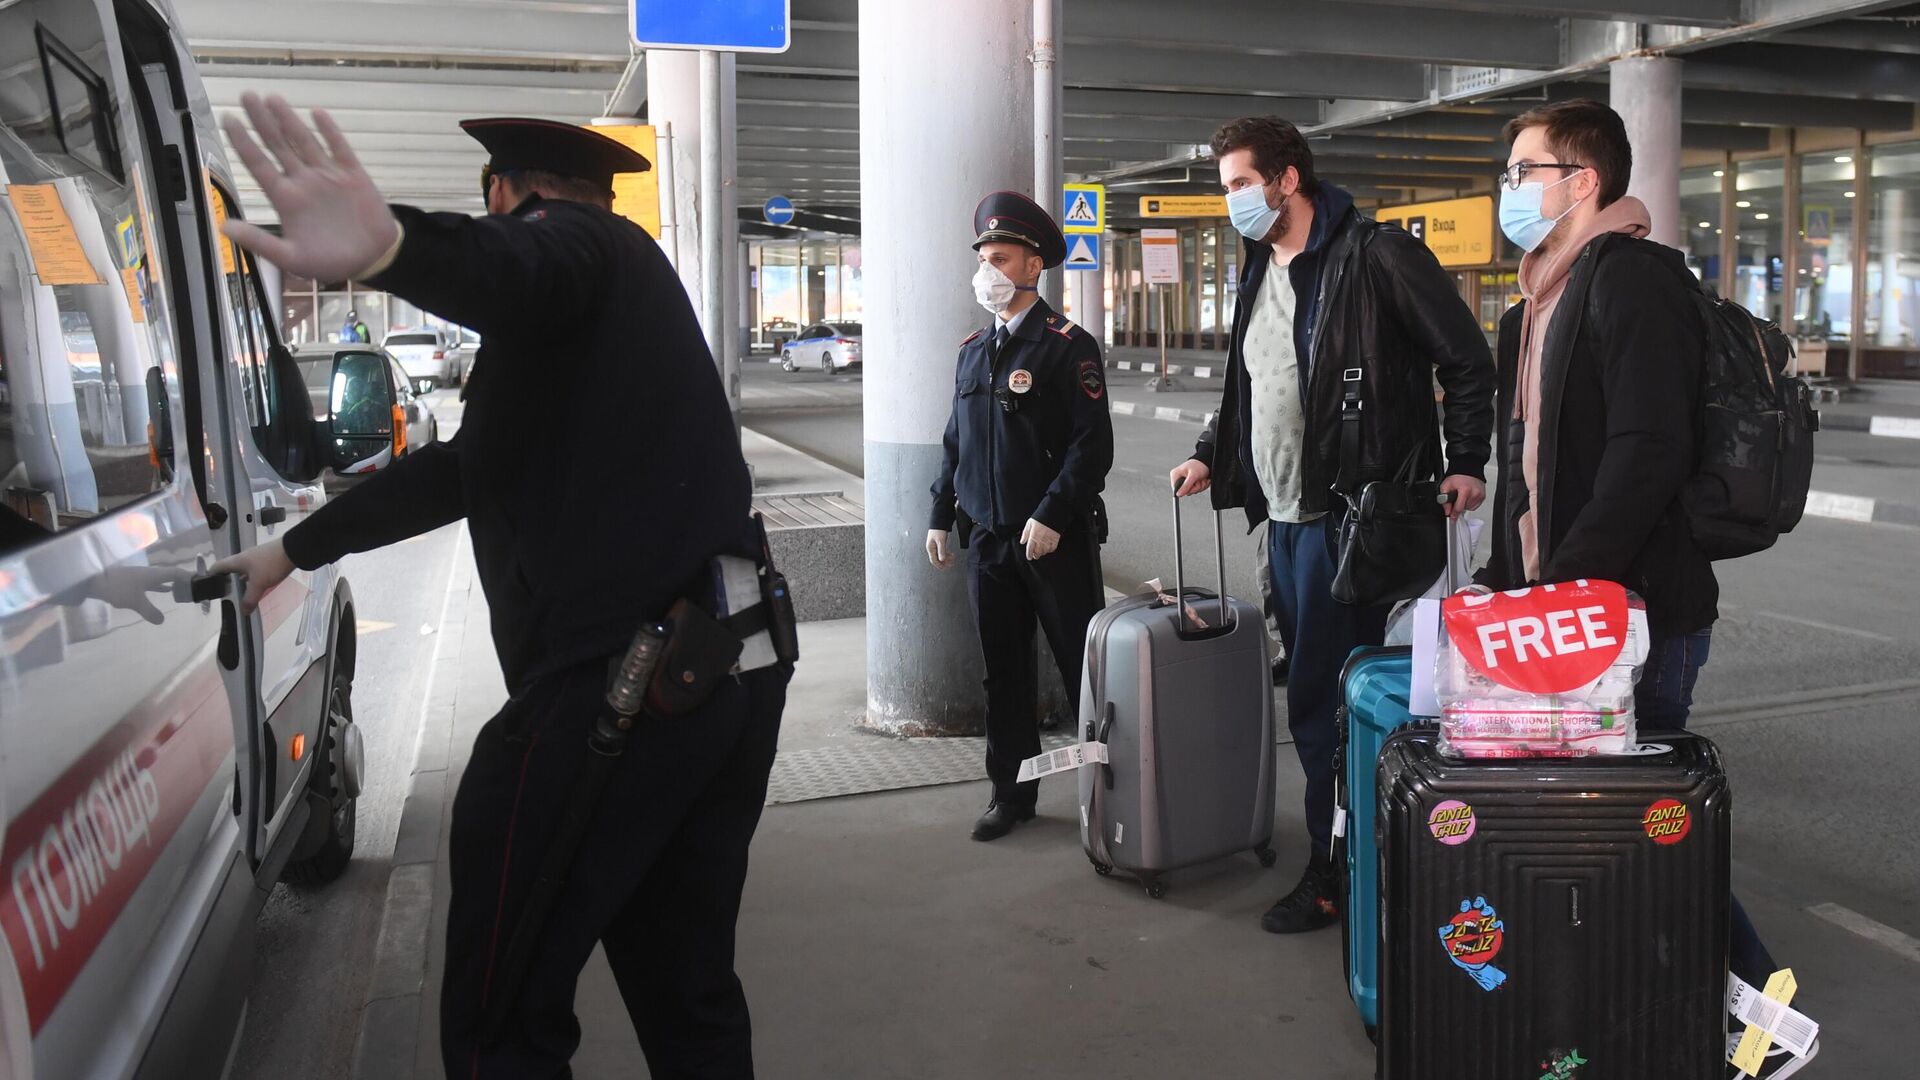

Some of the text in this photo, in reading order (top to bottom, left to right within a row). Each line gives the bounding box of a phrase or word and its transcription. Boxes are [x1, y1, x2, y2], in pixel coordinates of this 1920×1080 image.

[1432, 218, 1455, 233] Вход
[1476, 605, 1617, 669] FREE
[1478, 716, 1555, 726] INTERNATIONAL
[1427, 805, 1472, 824] SANTA
[1641, 804, 1686, 823] SANTA
[1434, 821, 1470, 838] CRUZ
[1648, 820, 1685, 837] CRUZ
[12, 745, 159, 971] ПОМОЩЬ
[1731, 983, 1745, 1006] SVO
